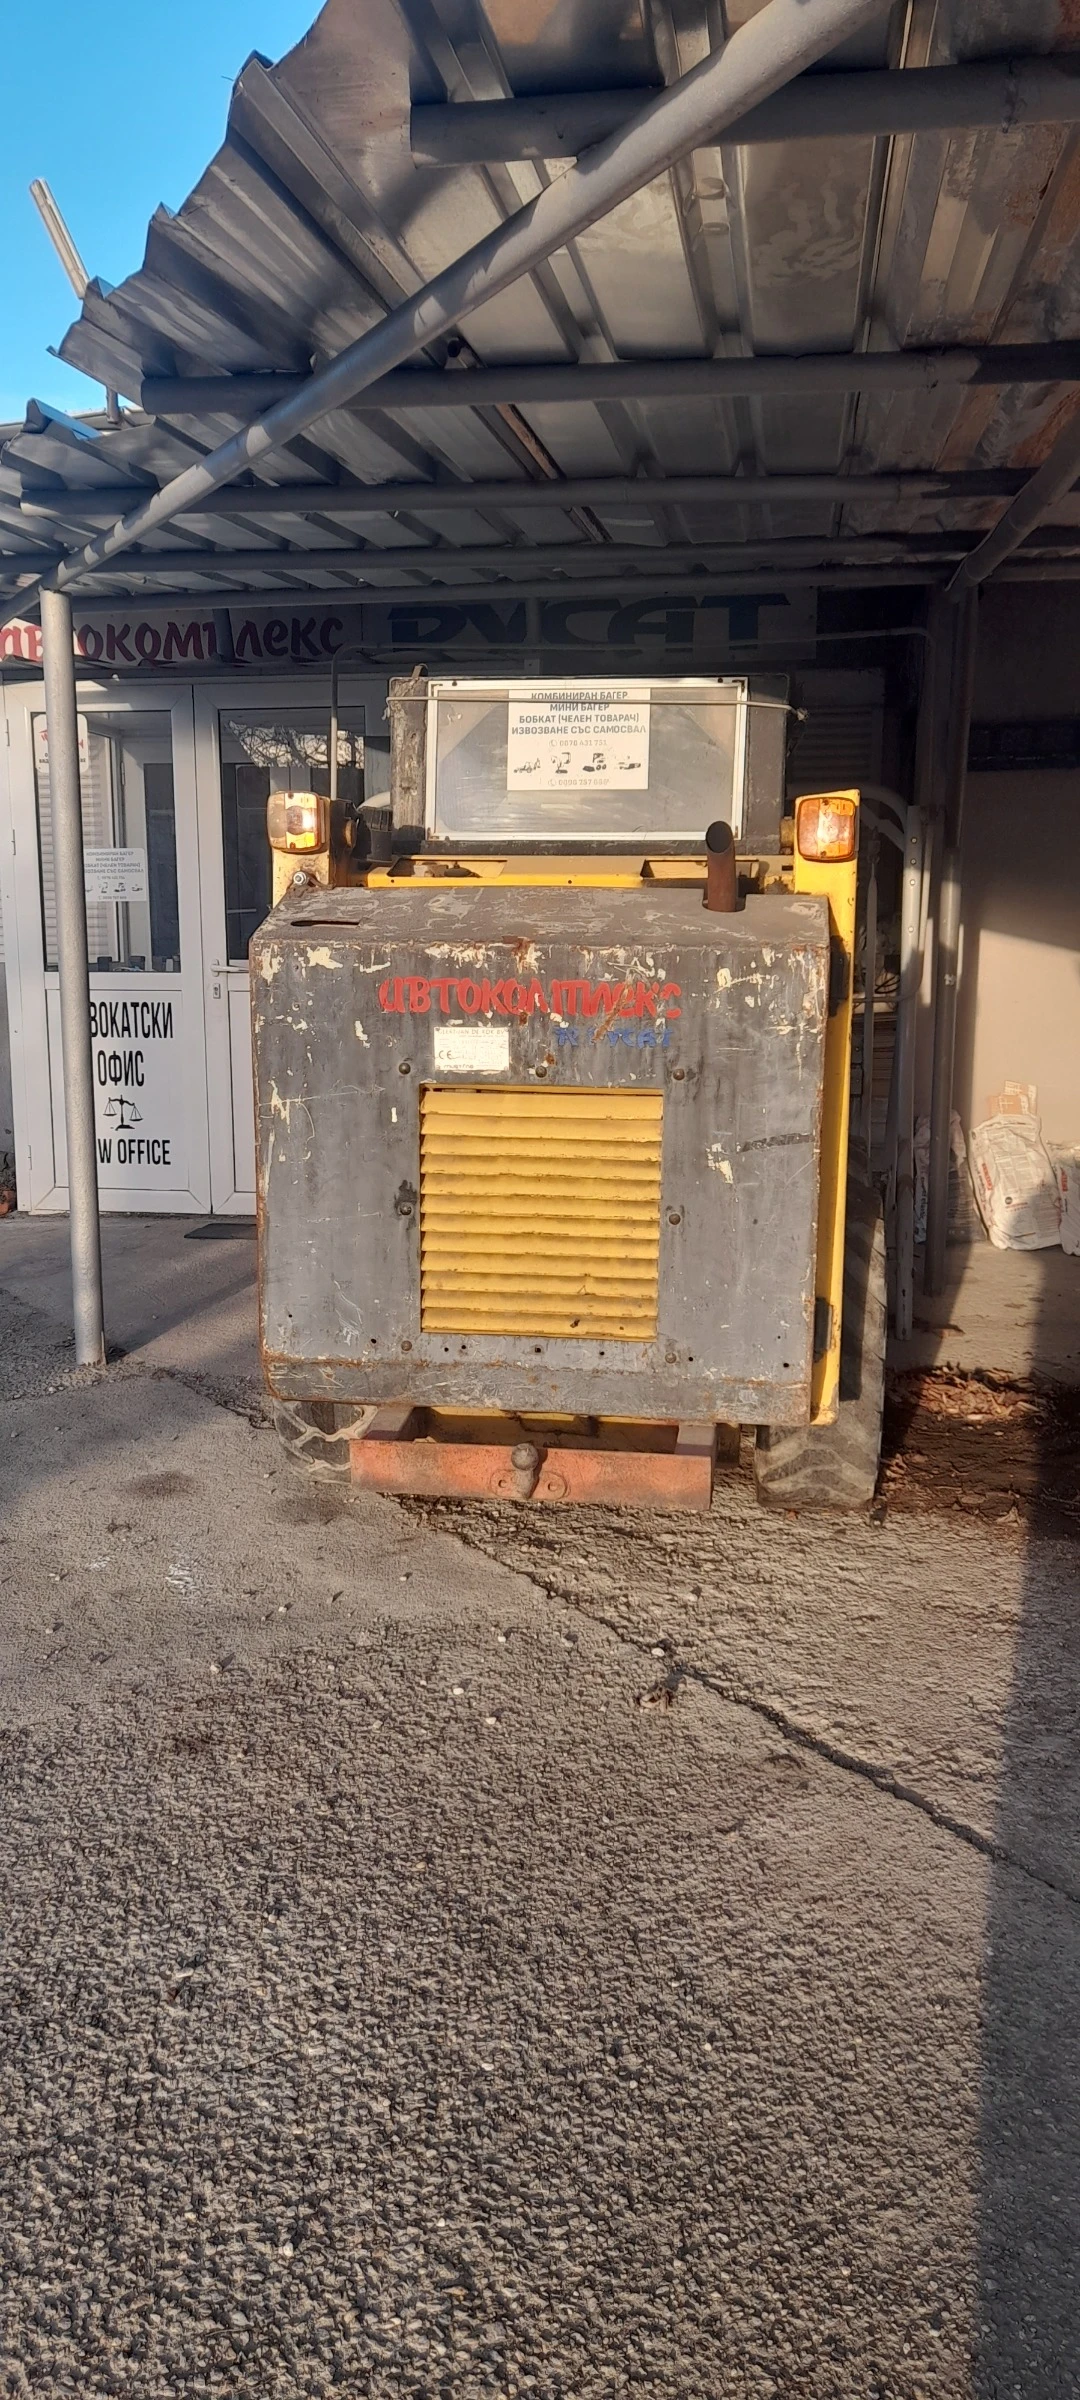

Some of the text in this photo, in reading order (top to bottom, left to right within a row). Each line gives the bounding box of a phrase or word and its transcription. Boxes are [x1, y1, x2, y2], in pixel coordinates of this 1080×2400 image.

[531, 691, 628, 700] КОМБИНИРАН БАГЕР
[550, 702, 610, 711] МИНИ БАГЕР
[519, 715, 556, 723] БОБКАТ
[511, 725, 647, 735] ИЗВОЗВАНЕ СЪС САМОСВАЛ
[97, 1050, 145, 1087] ОФИС
[117, 1138, 171, 1165] OFFICE
